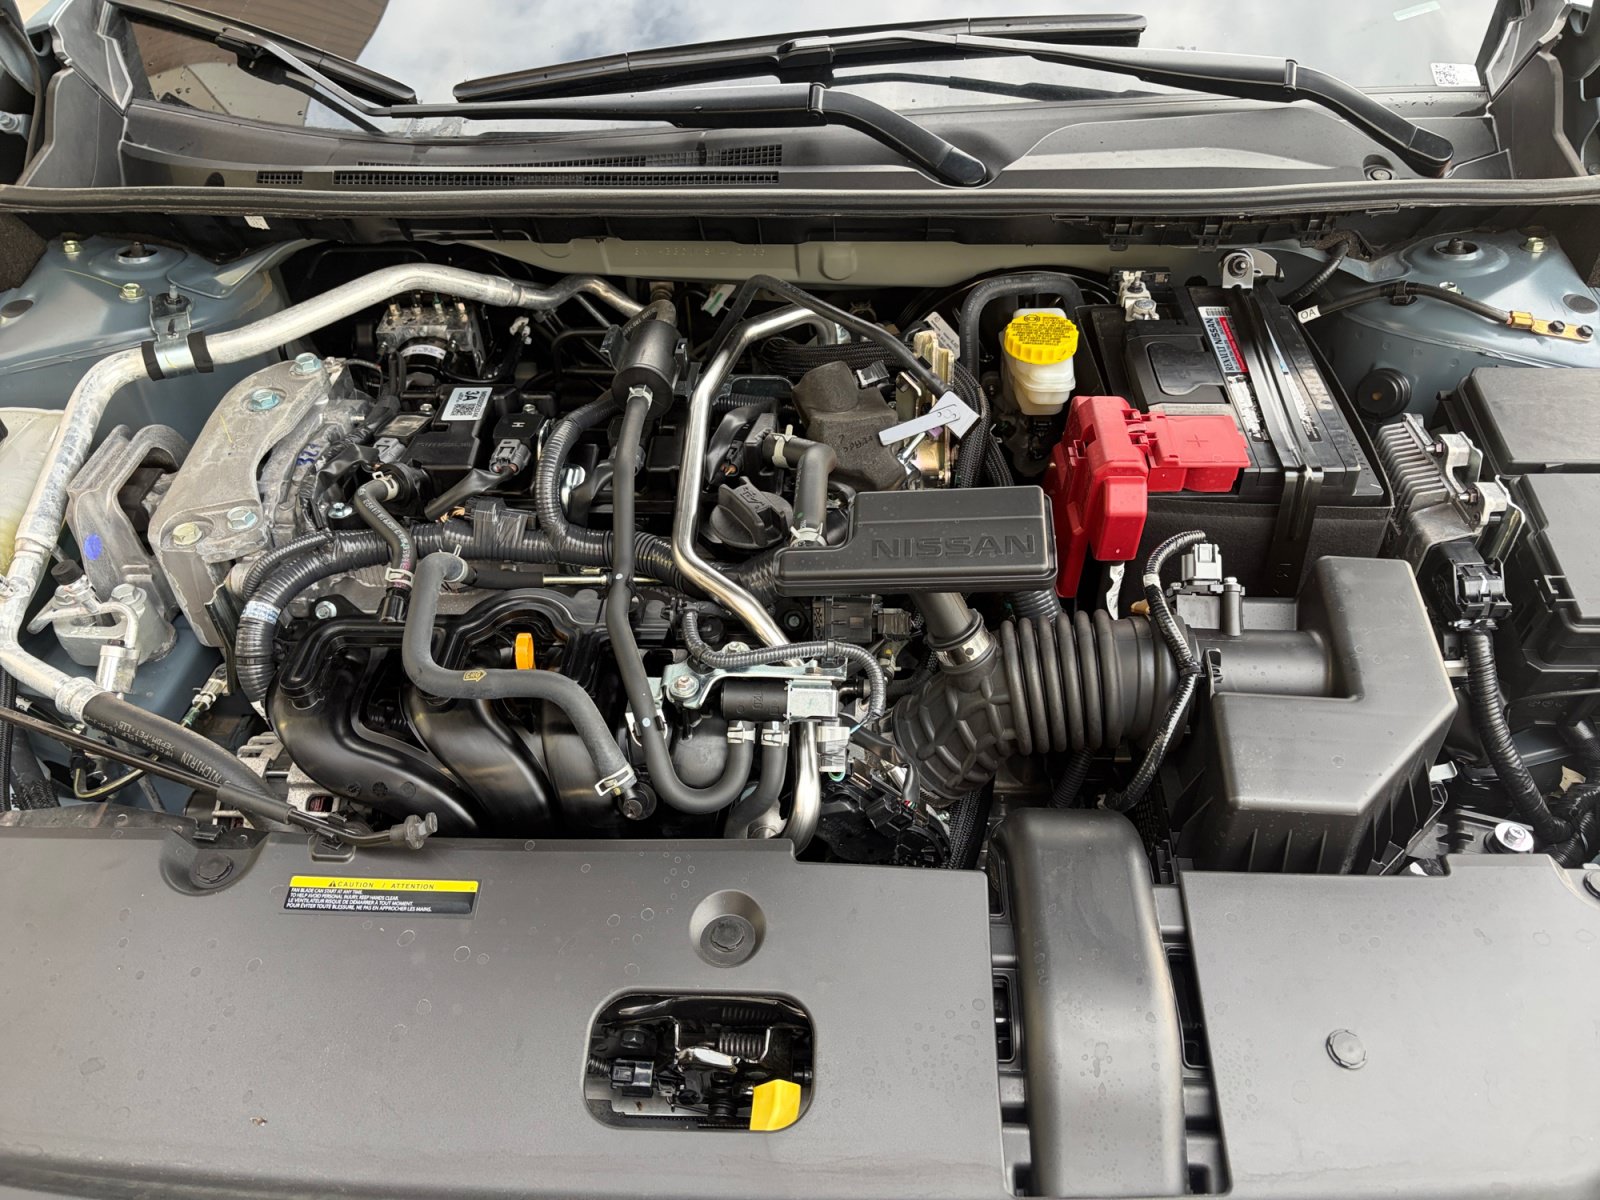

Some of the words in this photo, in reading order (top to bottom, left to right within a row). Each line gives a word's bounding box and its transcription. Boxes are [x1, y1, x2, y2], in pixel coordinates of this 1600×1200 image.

[1205, 317, 1224, 344] NISSAN
[1215, 343, 1235, 373] RENAULT
[462, 390, 480, 402] 3A
[871, 533, 1036, 561] NISSAN
[180, 751, 222, 783] NICHIRIN
